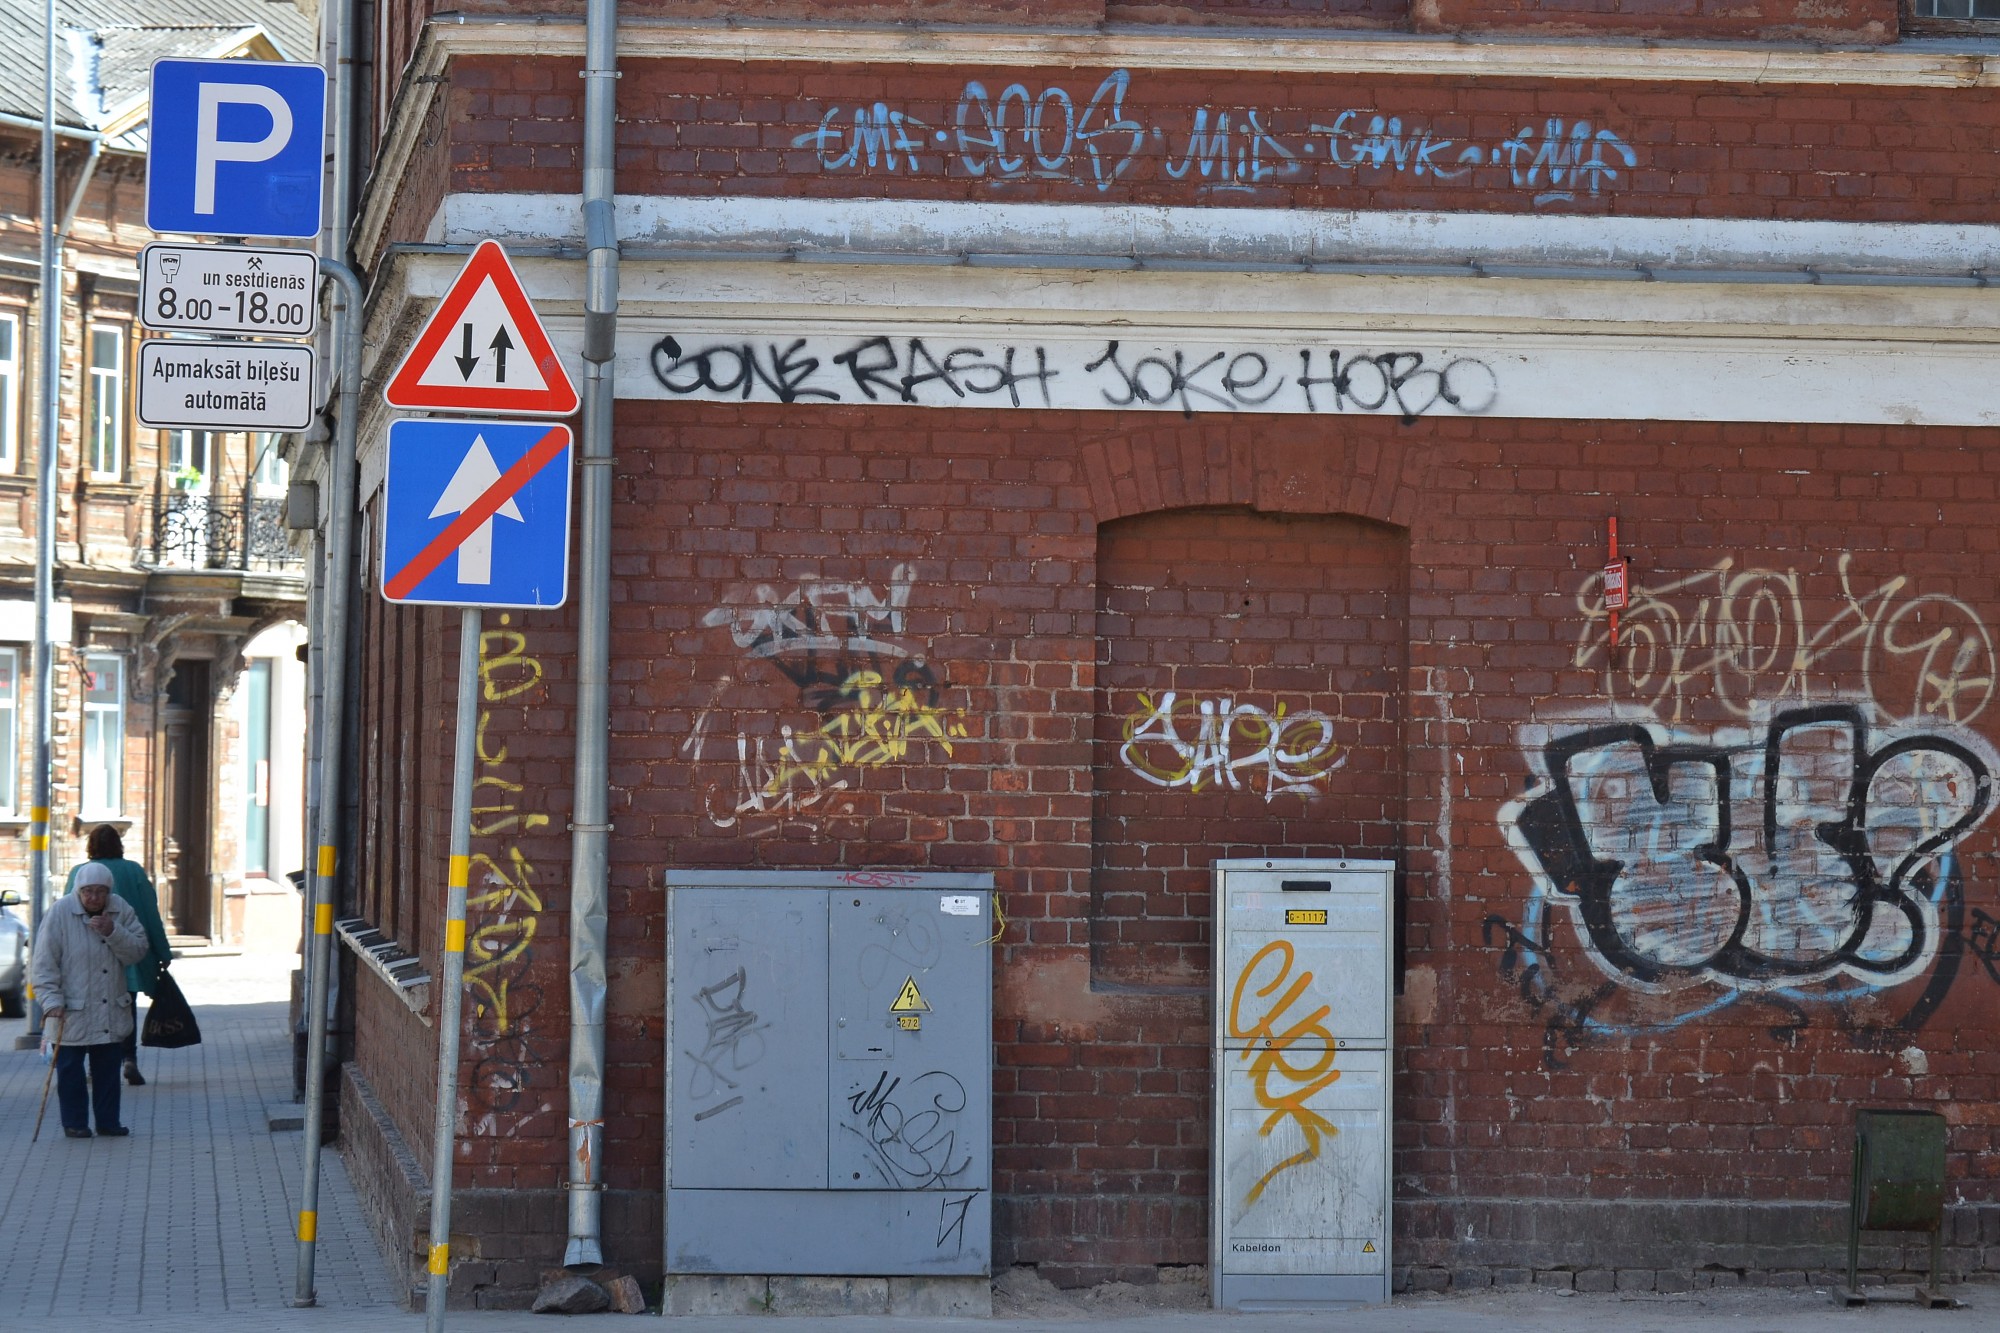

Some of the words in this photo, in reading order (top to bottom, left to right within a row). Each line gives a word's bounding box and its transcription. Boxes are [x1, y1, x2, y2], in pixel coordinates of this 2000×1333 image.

[194, 82, 294, 215] P
[203, 272, 221, 286] un
[225, 272, 305, 290] sestdienās
[153, 357, 242, 383] Apmaksāt
[247, 360, 300, 386] biļešu
[185, 390, 266, 411] automātā
[901, 1018, 918, 1028] 272
[1232, 1243, 1281, 1252] Kabeldon
